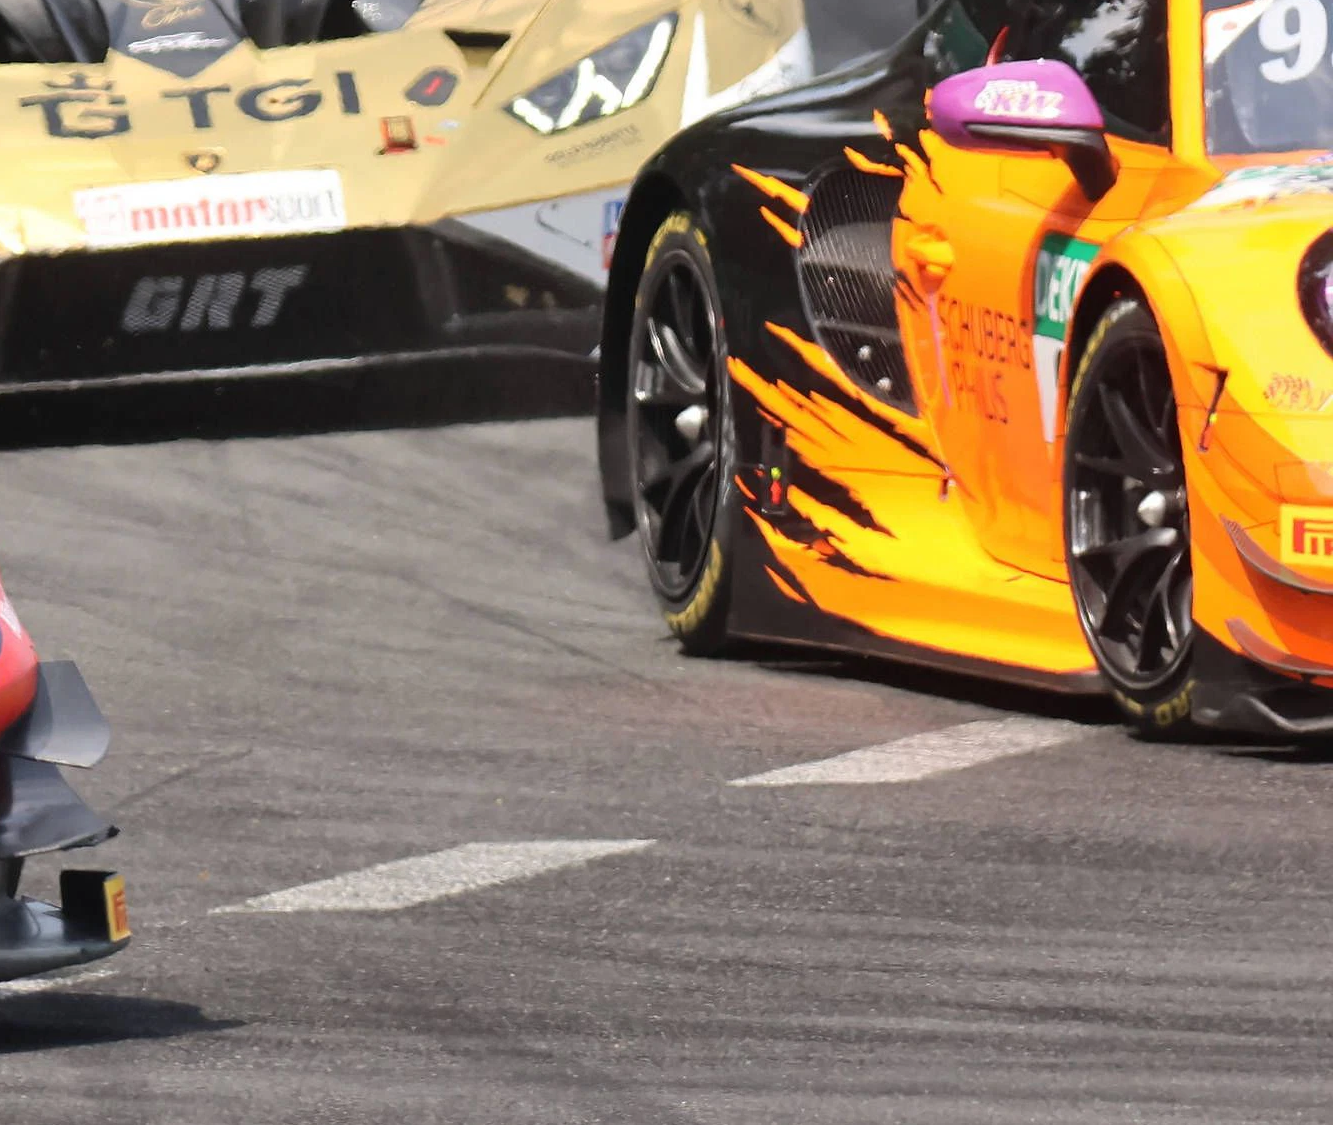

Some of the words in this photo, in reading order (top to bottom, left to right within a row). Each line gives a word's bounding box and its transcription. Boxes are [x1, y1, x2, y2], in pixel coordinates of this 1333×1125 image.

[130, 188, 338, 232] motorsport
[121, 263, 312, 333] GRT
[1035, 249, 1090, 324] DEK
